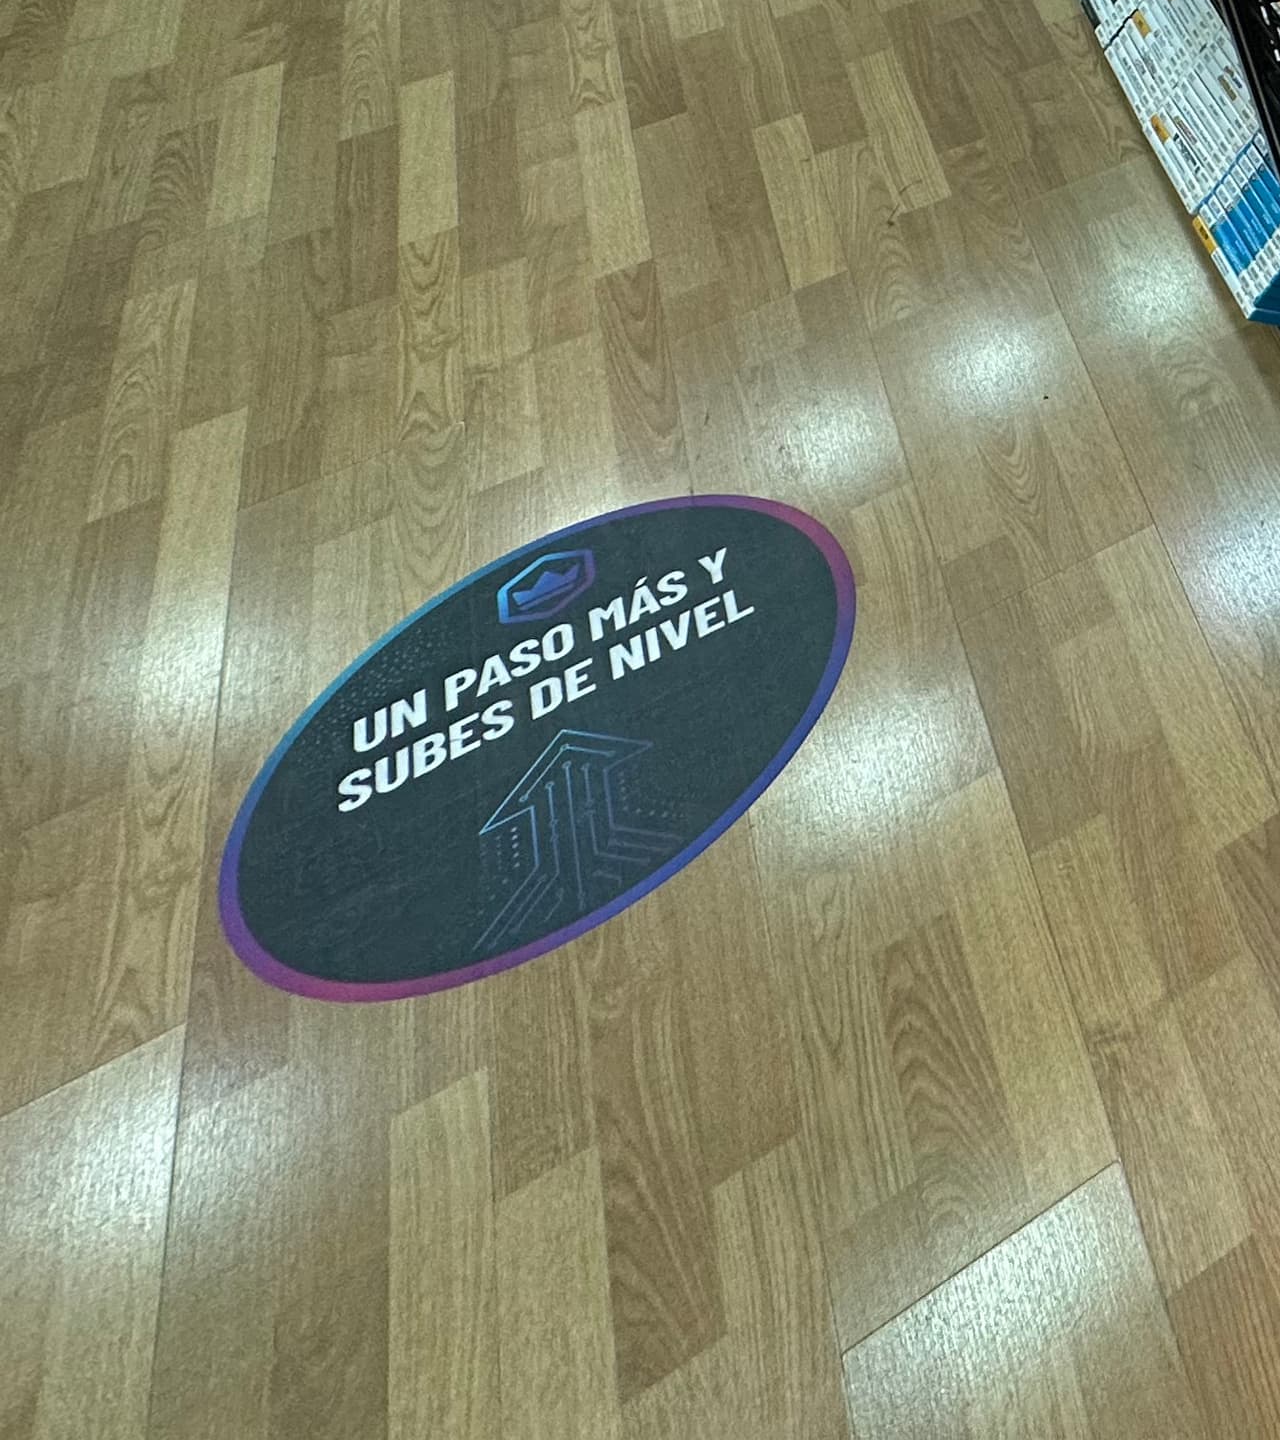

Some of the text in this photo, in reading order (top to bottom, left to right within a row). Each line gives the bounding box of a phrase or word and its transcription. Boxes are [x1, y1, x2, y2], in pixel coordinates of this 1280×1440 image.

[337, 588, 755, 815] SUBES DE NIVEL
[353, 547, 729, 752] UN PASO MÁS Y
